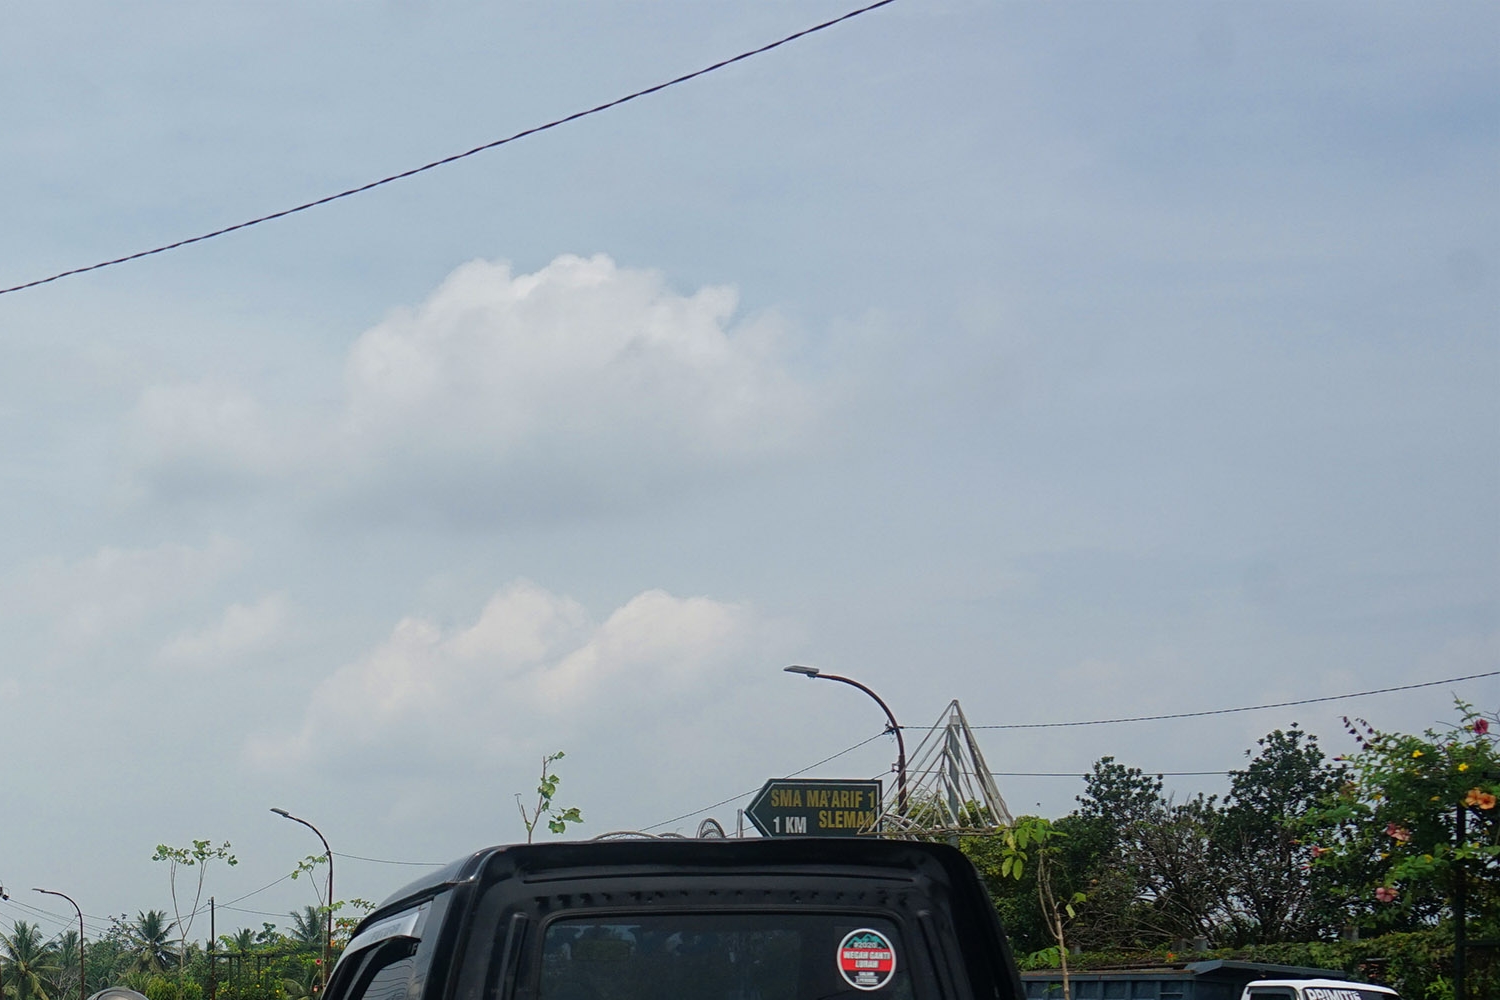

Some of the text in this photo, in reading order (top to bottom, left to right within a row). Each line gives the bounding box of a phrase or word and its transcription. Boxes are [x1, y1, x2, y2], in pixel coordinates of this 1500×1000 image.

[770, 789, 803, 808] SMA
[868, 790, 875, 808] 1
[773, 816, 807, 834] 1 KM
